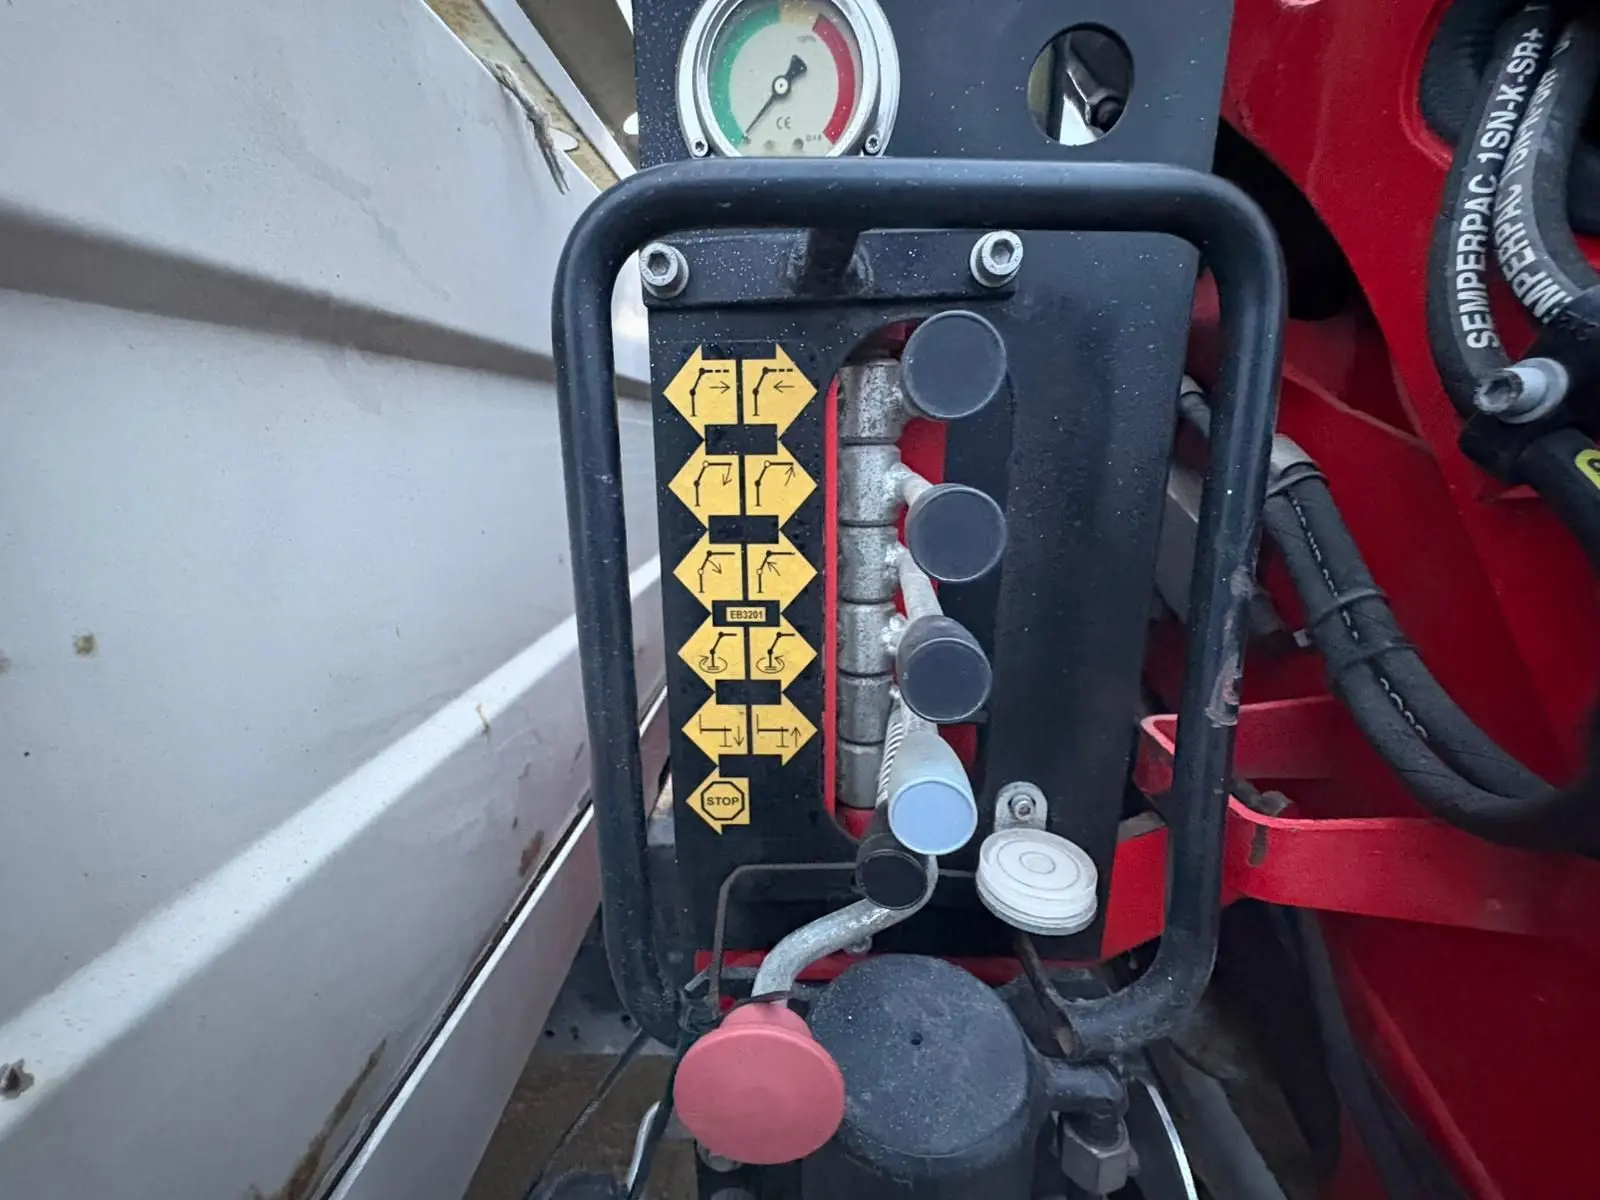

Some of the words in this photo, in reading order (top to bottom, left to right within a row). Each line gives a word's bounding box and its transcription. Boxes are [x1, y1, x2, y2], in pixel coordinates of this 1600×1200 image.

[776, 116, 791, 130] CE
[1456, 174, 1500, 349] SEMPERPAC
[730, 610, 764, 620] EB3201
[706, 796, 740, 806] STOP
